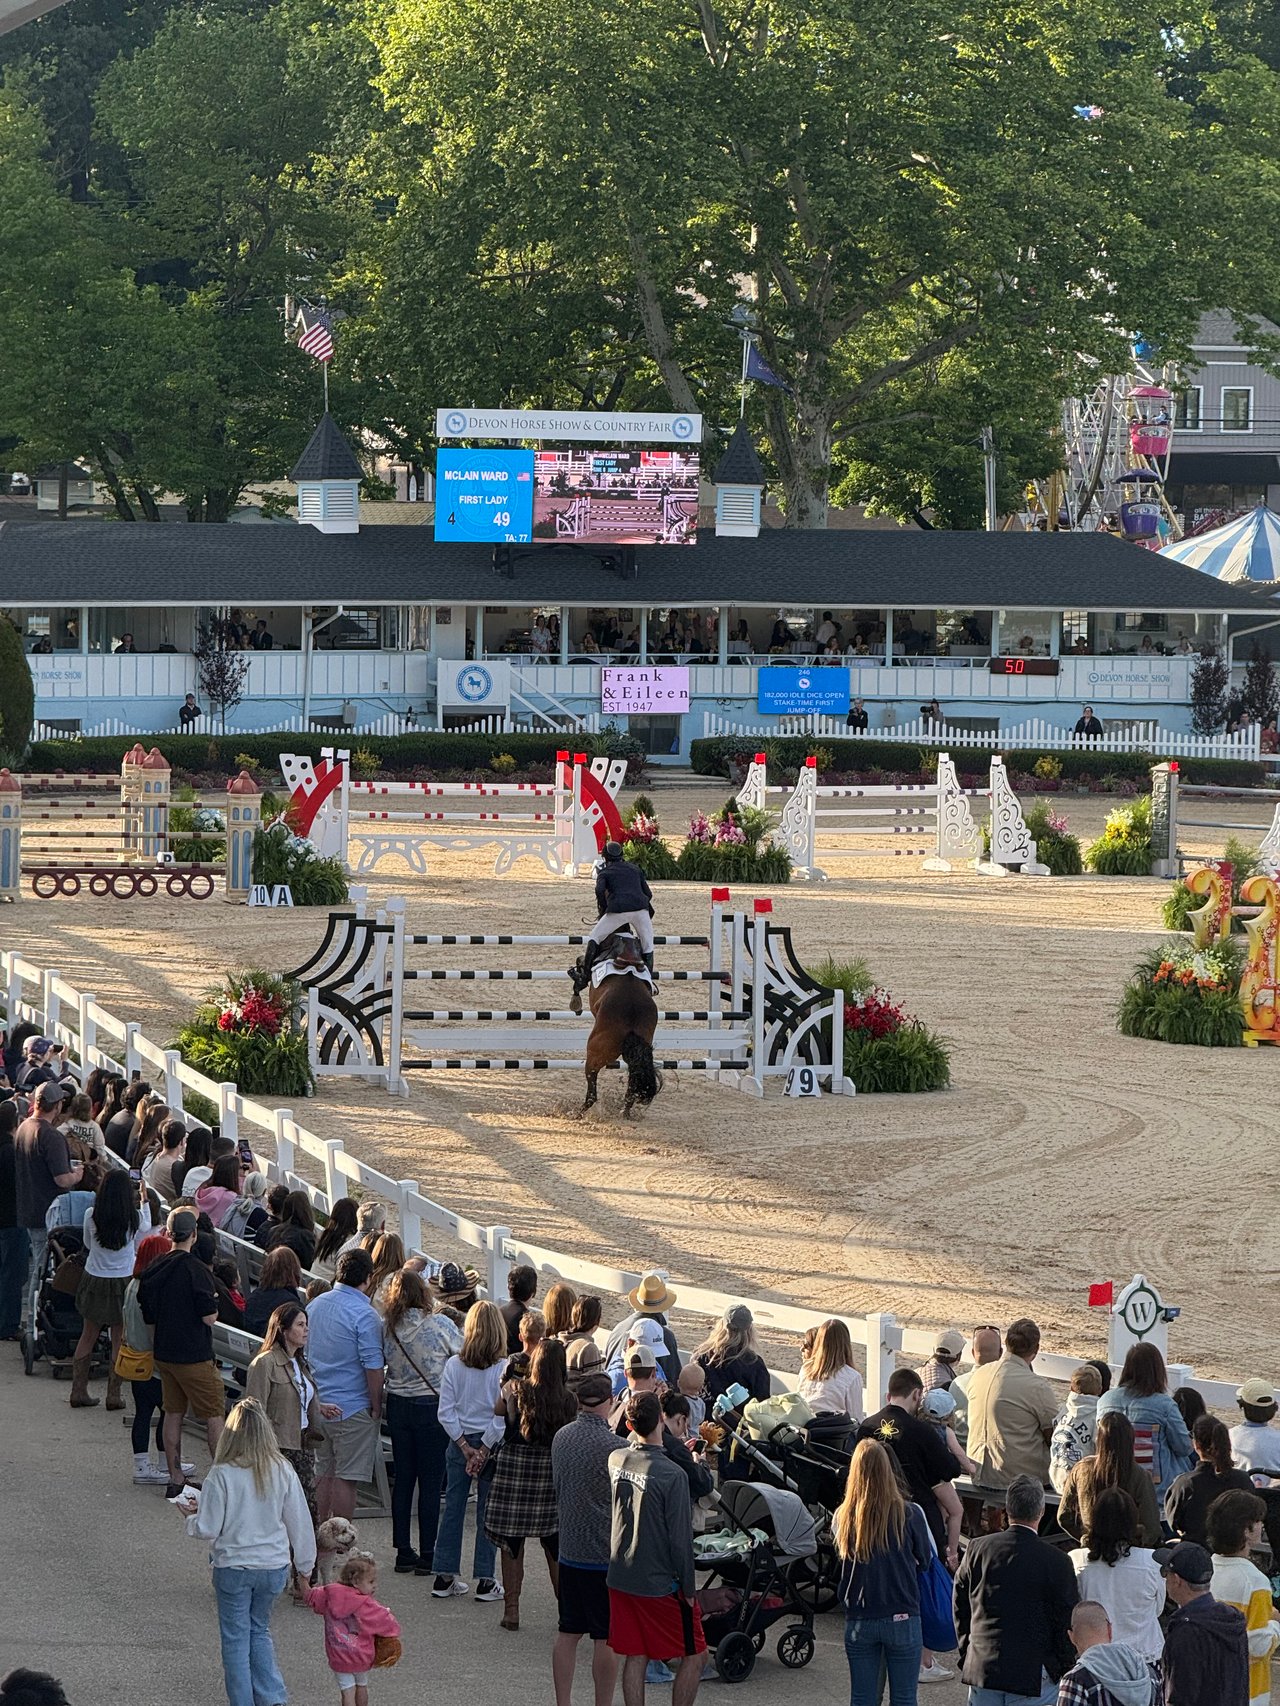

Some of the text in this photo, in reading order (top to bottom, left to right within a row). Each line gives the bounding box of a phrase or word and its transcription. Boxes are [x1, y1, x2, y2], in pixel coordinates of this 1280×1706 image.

[469, 416, 508, 430] DEVON
[510, 418, 547, 430] HORSE
[549, 418, 582, 431] SHOW
[583, 420, 592, 431] &
[593, 420, 646, 432] COUNTRY
[648, 421, 672, 433] FAIR
[444, 471, 509, 481] MCLAIN WARD
[459, 495, 508, 505] FIRST LADY
[447, 511, 456, 525] 4
[493, 511, 511, 527] 49
[505, 533, 528, 543] TA: 77
[1006, 659, 1024, 674] 50
[41, 670, 62, 680] HORSE
[64, 670, 82, 680] SHOW
[603, 669, 663, 682] Frank
[1099, 671, 1170, 684] DEVON HORSE SHOW
[603, 686, 689, 699] & Eileen
[626, 702, 653, 712] 1947
[254, 885, 266, 904] 10
[277, 887, 289, 905] A
[785, 1068, 796, 1093] 9
[799, 1068, 814, 1094] 9
[1131, 1301, 1153, 1324] W
